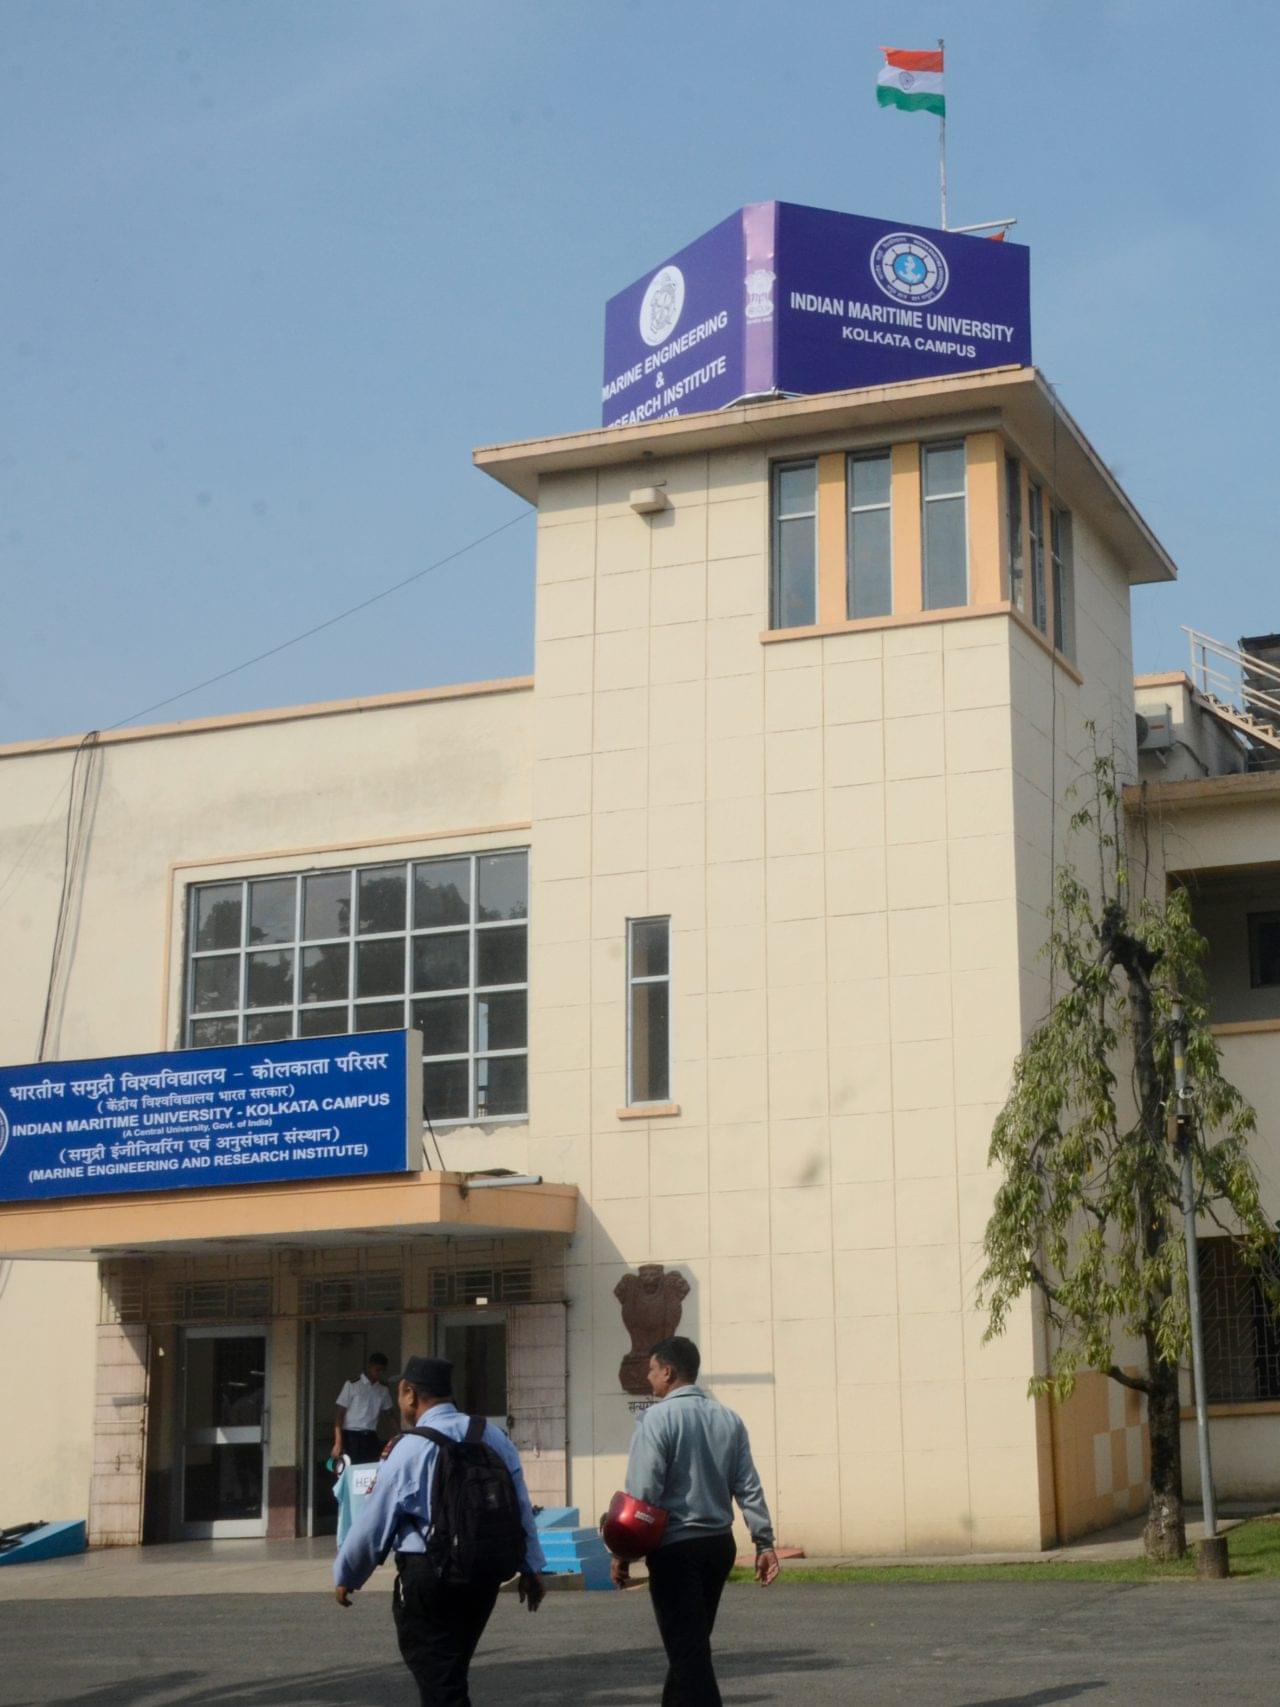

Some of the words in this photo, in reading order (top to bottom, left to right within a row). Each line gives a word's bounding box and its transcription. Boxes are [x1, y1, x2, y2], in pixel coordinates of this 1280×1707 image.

[791, 292, 844, 316] INDIAN
[849, 302, 922, 328] MARITIME
[927, 314, 1014, 342] UNIVERSITY
[602, 363, 642, 402] MARINE
[645, 311, 728, 374] ENGINEERING
[842, 326, 911, 348] KOLKATA
[915, 338, 976, 358] CAMPUS
[656, 371, 664, 388] &
[664, 356, 726, 406] INSTITUTE
[10, 1079, 65, 1100] भारतीय
[70, 1074, 114, 1099] समुद्री
[120, 1068, 226, 1092] विश्वविद्यालय
[250, 1058, 330, 1080] कोलकाता
[334, 1052, 389, 1073] परिसर
[12, 1121, 62, 1136] INDIAN
[66, 1115, 139, 1132] MARITIME
[144, 1106, 233, 1126] UNIVERSITY
[246, 1100, 318, 1117] KOLKATA
[322, 1093, 390, 1110] CAMPUS
[142, 1092, 213, 1109] विश्वविद्यालय
[219, 1089, 246, 1102] भारत
[250, 1084, 295, 1099] सरकार)
[111, 1137, 184, 1160] इंजीनियरिंग
[188, 1134, 210, 1151] एवं
[216, 1132, 278, 1153] अनुसंधान
[122, 1130, 132, 1138] (A
[134, 1127, 164, 1137] Central
[212, 1120, 236, 1131] Govt.
[237, 1119, 246, 1128] of
[248, 1118, 272, 1128] India)
[28, 1166, 84, 1183] (MARINE
[88, 1159, 178, 1176] ENGINEERING
[181, 1155, 210, 1168] AND
[214, 1150, 289, 1166] RESEARCH
[293, 1144, 368, 1160] INSTITUTE)
